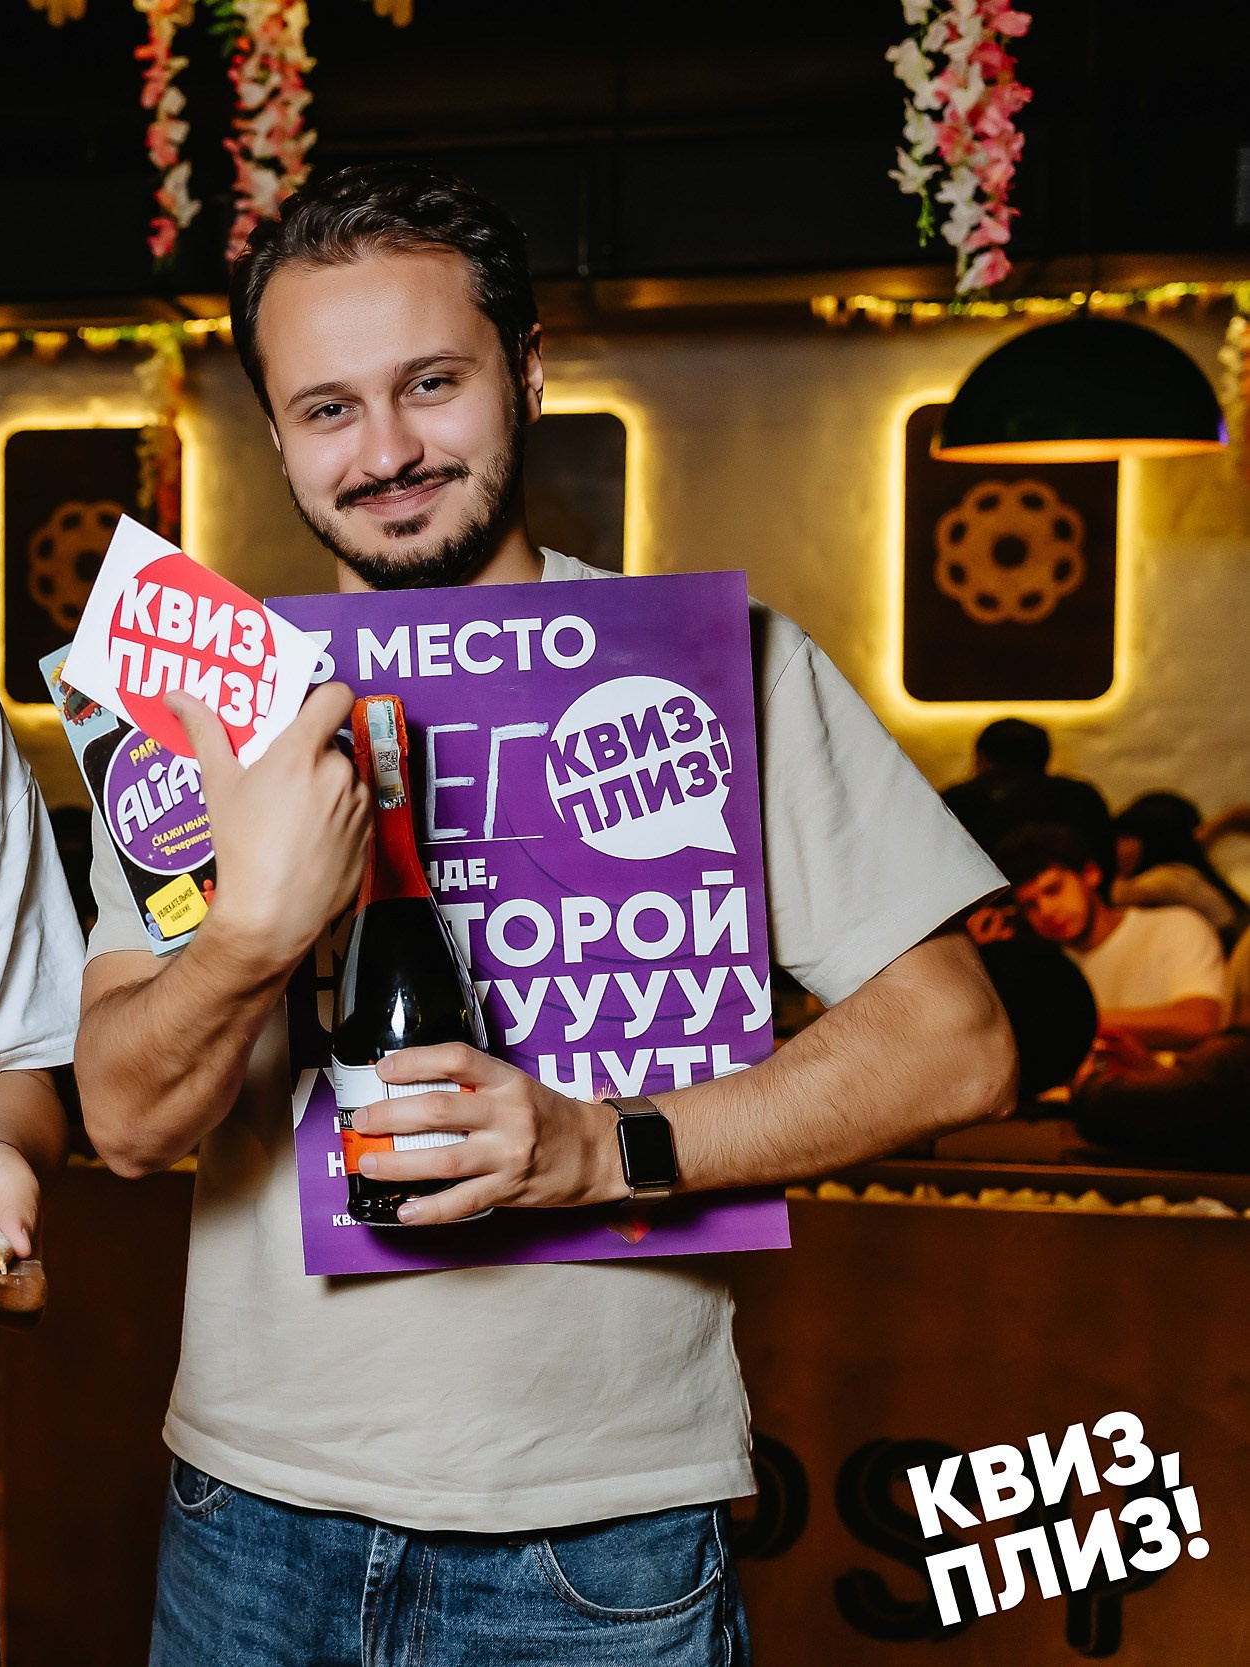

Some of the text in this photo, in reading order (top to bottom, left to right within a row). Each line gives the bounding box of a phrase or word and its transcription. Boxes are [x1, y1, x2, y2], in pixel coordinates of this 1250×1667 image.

[119, 577, 278, 683] КВИЗ,
[357, 615, 597, 681] МЕСТО
[111, 636, 274, 733] ПЛИЗ!
[549, 695, 722, 787] КВИЗ,
[152, 813, 211, 848] СКАЖИ ИНАЧ
[556, 741, 734, 836] ПЛИЗ!
